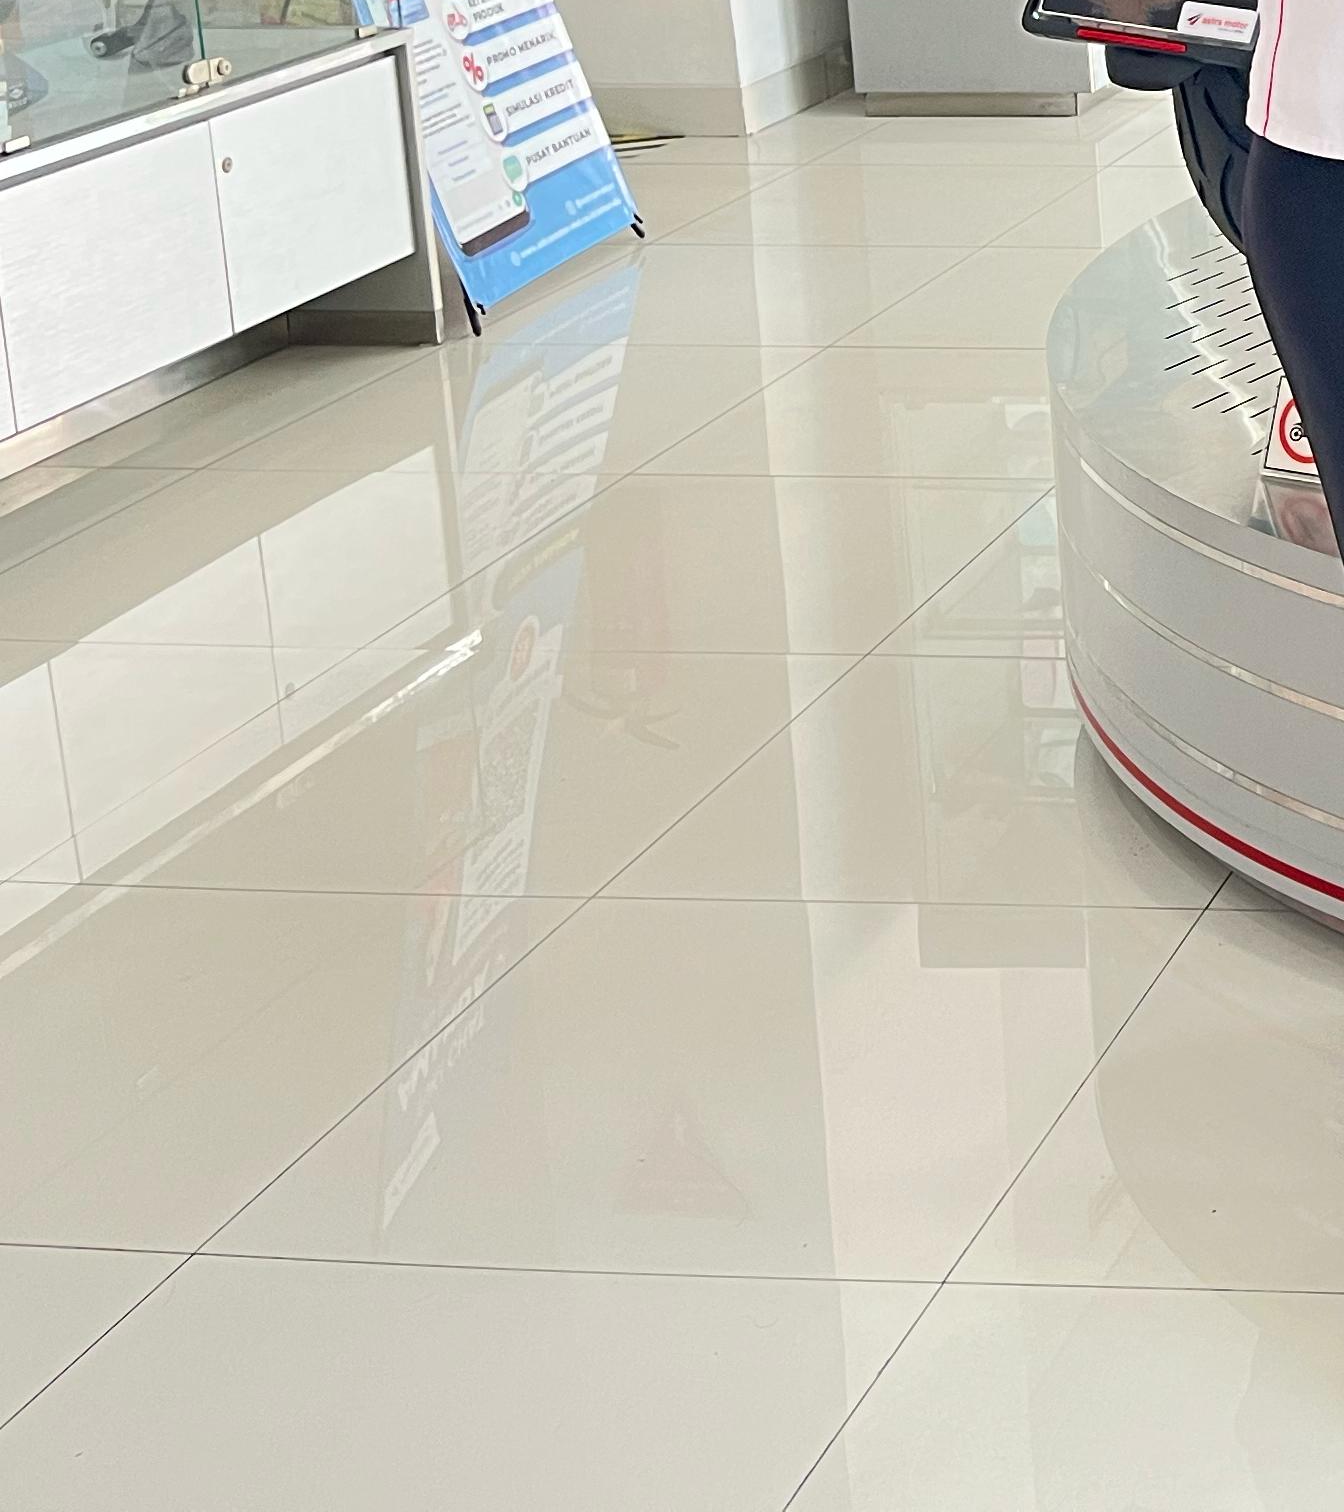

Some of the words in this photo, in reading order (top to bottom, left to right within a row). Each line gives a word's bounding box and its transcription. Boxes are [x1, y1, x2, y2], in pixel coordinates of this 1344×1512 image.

[1201, 16, 1222, 27] astra
[1224, 19, 1249, 30] motor
[486, 44, 517, 66] PROMO
[544, 78, 575, 99] KREDIT
[525, 146, 552, 165] PUSAT
[551, 128, 592, 154] BANTUAN
